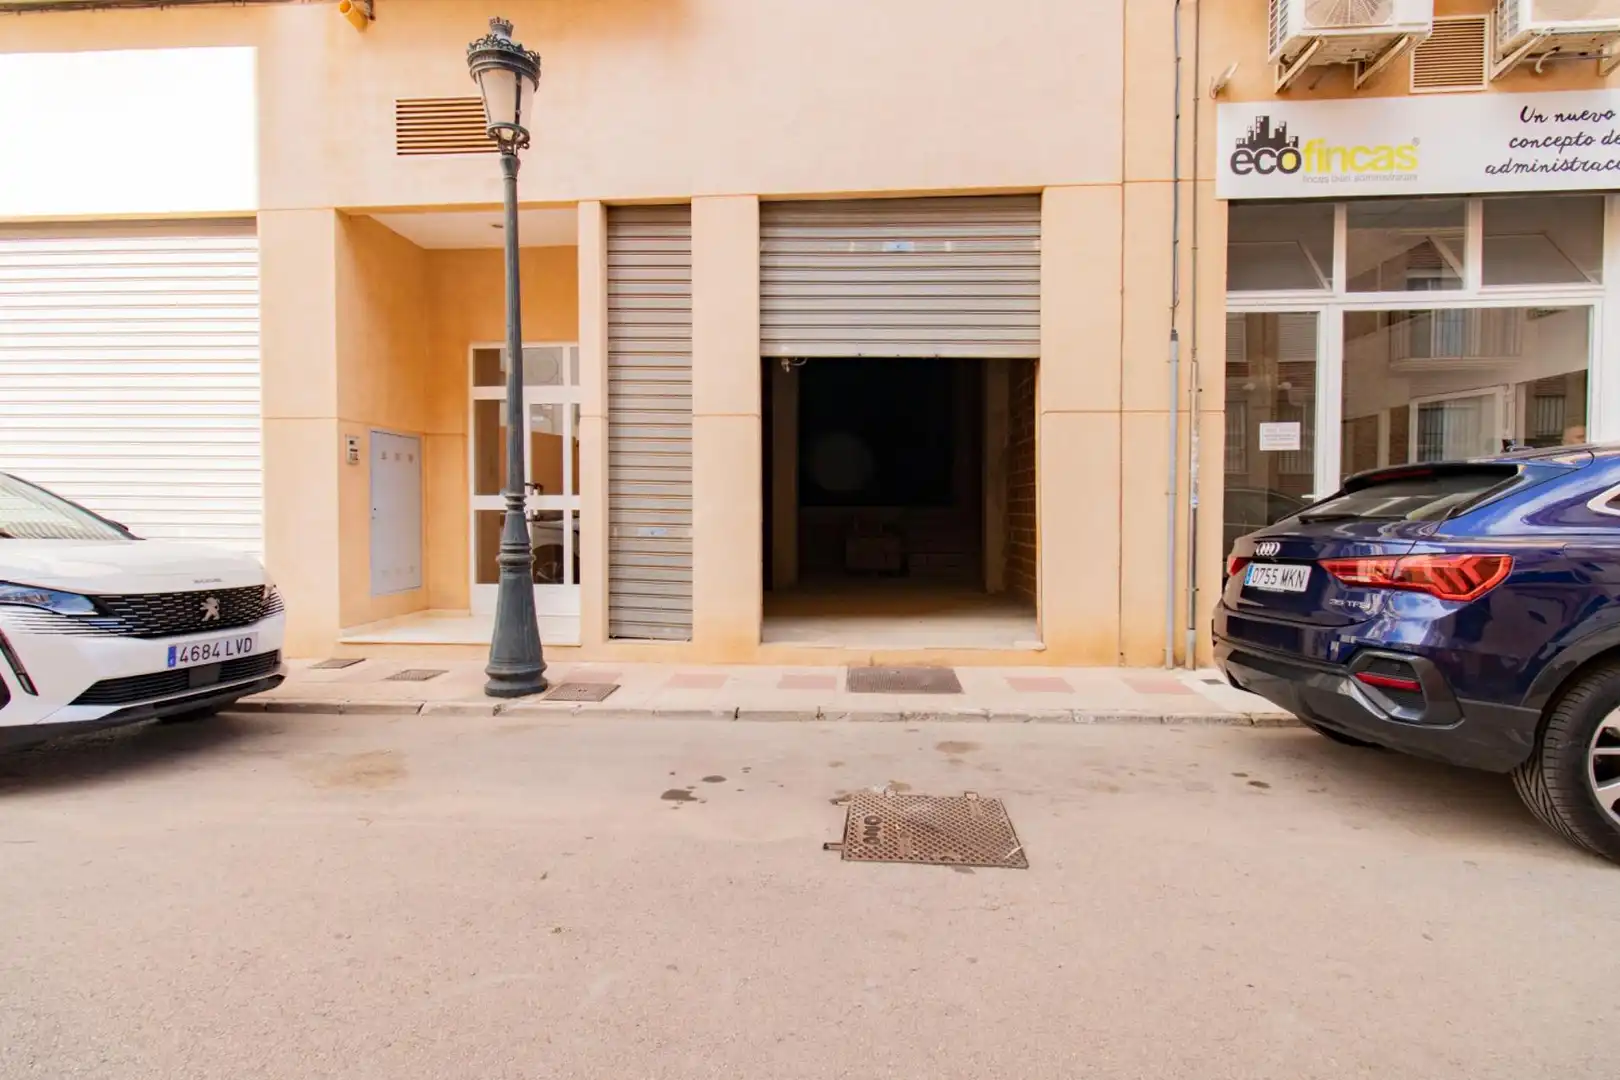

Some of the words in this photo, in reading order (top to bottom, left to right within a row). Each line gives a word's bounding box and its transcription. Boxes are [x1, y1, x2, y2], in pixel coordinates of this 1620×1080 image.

[1519, 105, 1548, 123] Un
[1554, 109, 1616, 123] nuevo
[1508, 131, 1596, 154] concepto
[1252, 567, 1278, 585] 0755
[1281, 568, 1305, 588] MKN
[179, 642, 220, 663] 4684
[225, 637, 252, 656] LVD
